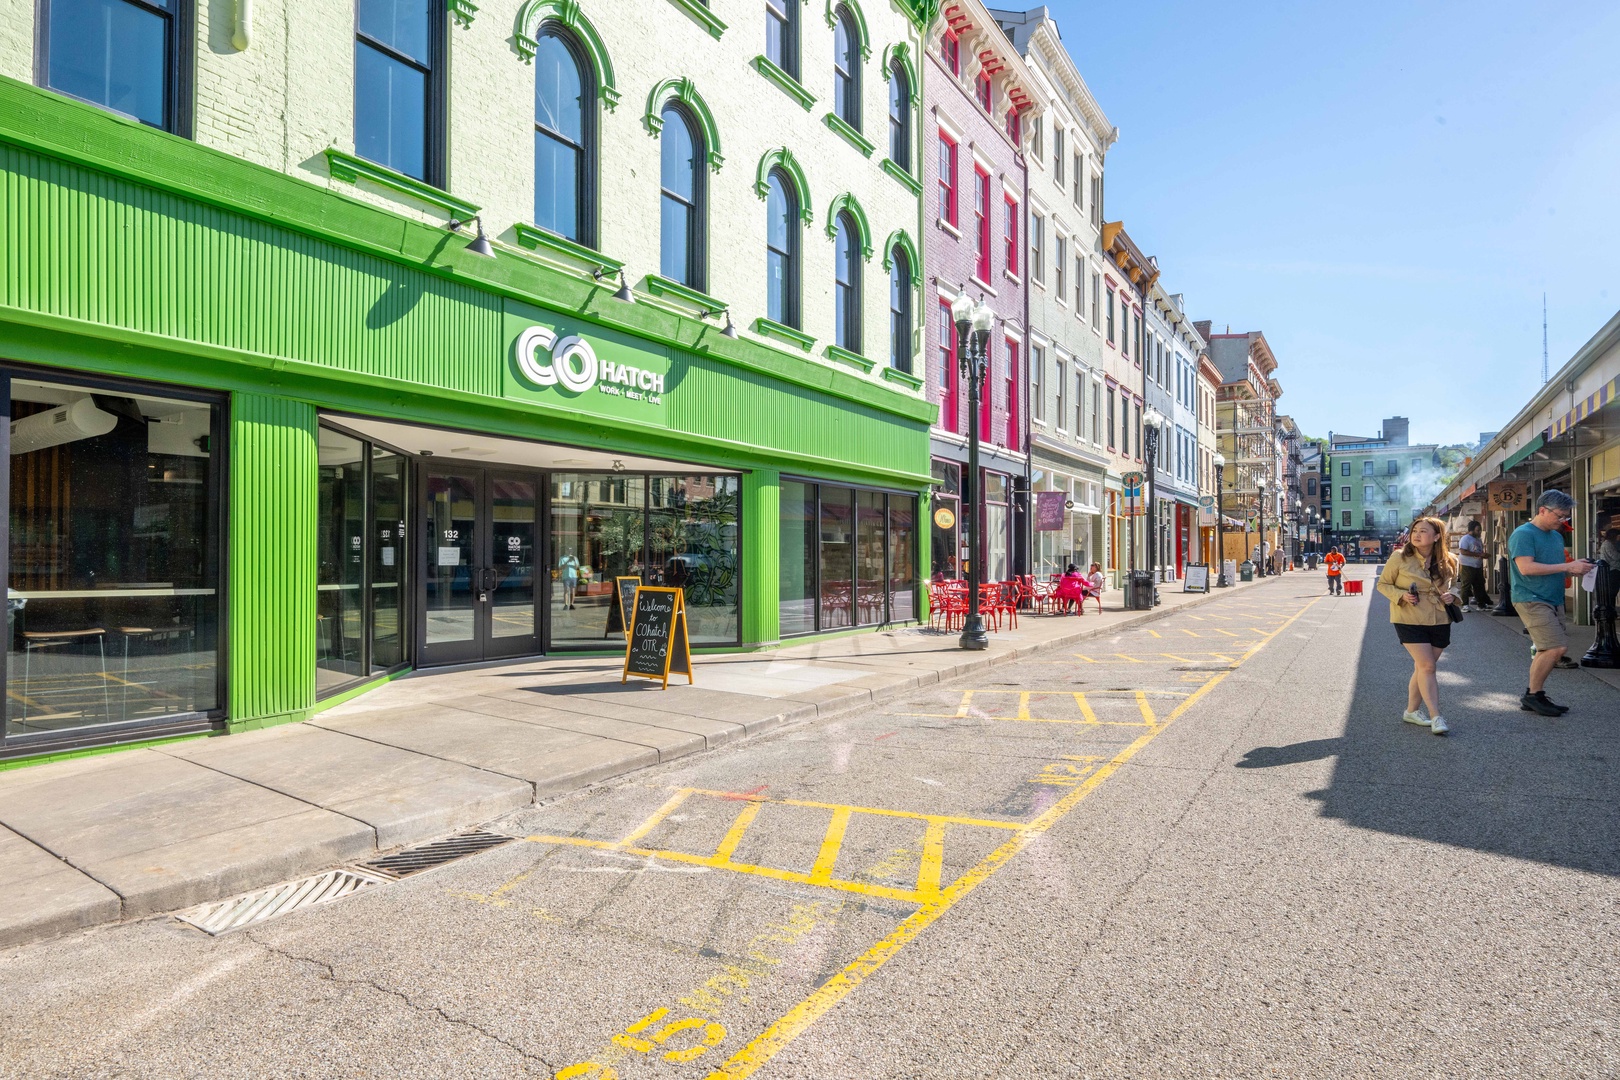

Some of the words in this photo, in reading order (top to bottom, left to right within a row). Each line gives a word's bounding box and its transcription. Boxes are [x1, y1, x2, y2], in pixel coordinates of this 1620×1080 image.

[515, 326, 598, 392] CO
[600, 360, 664, 394] HATCH
[600, 384, 620, 396] WORK
[625, 391, 642, 401] MEET
[443, 530, 459, 539] 132
[508, 536, 521, 545] CO
[639, 598, 672, 613] Welcome
[649, 613, 659, 622] to
[641, 638, 658, 653] OTR
